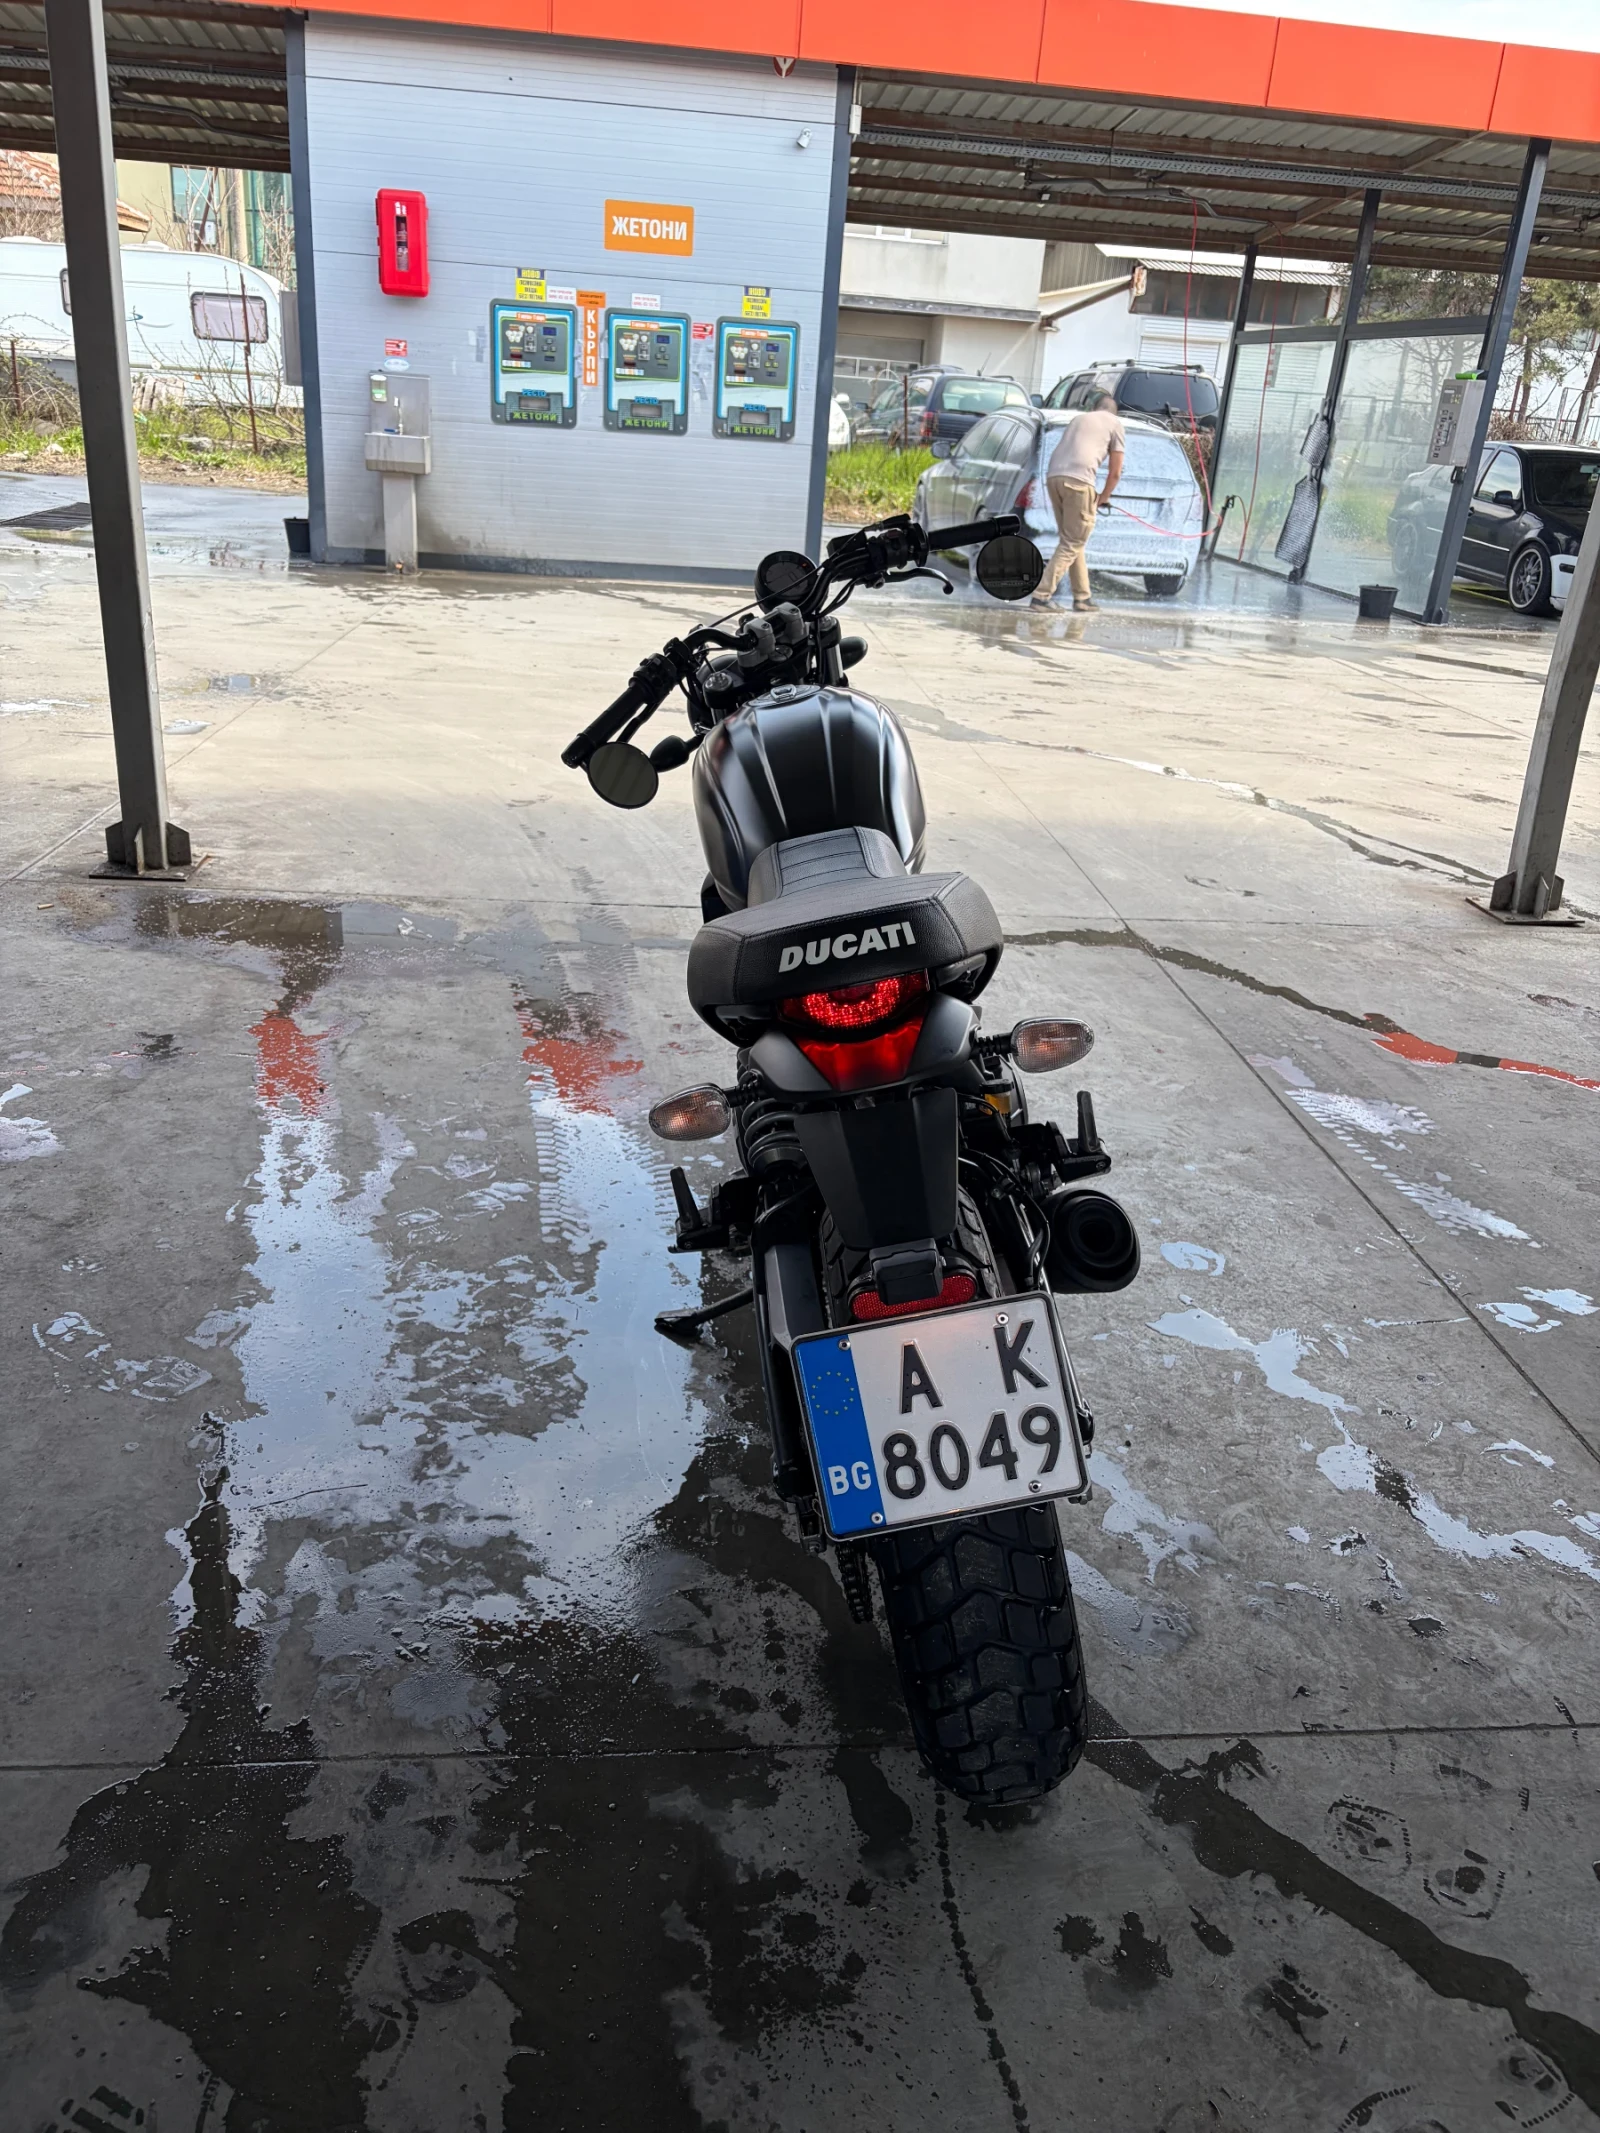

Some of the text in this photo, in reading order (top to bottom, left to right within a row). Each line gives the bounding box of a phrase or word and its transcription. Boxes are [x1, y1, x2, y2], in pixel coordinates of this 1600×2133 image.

[612, 215, 687, 241] ЖЕТОНИ
[586, 309, 596, 384] КЪРПИ
[512, 411, 558, 422] ЖЕТОНИ
[625, 418, 669, 429] ЖЕТОНИ
[733, 425, 776, 436] ЖЕТОНИ
[778, 922, 917, 973] DUCATI
[900, 1319, 1049, 1414] A K
[883, 1405, 1061, 1500] 8049
[828, 1461, 871, 1496] BG
